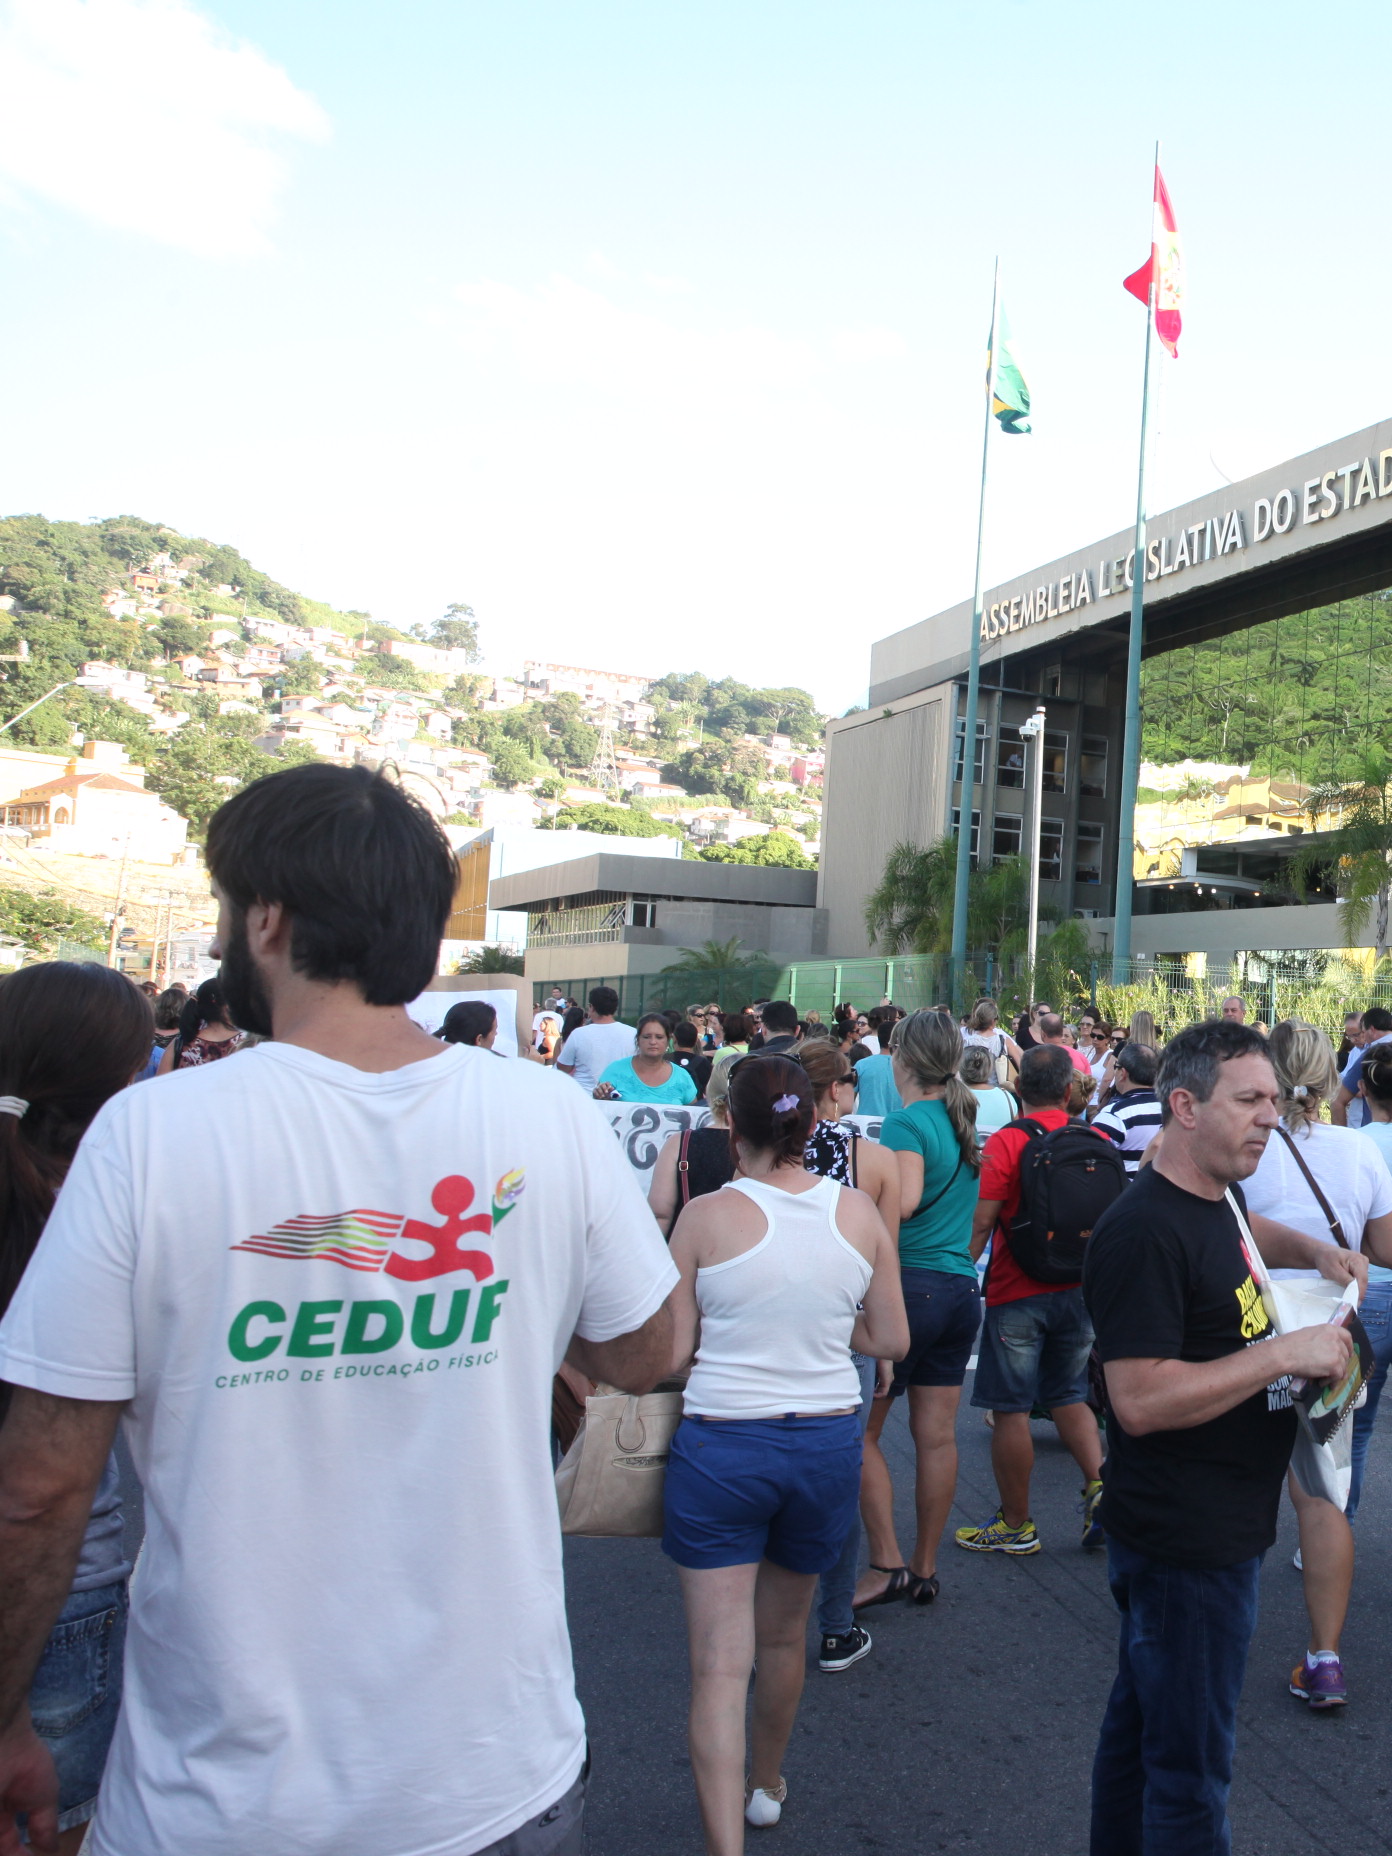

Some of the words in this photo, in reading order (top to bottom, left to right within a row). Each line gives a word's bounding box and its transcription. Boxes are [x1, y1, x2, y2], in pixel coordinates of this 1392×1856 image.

[980, 568, 1093, 641] ASSEMBLEIA
[1254, 488, 1295, 543] DO
[215, 1368, 290, 1389] CENTRO
[300, 1369, 325, 1382] DE
[333, 1358, 440, 1379] EDUCAÇÃO
